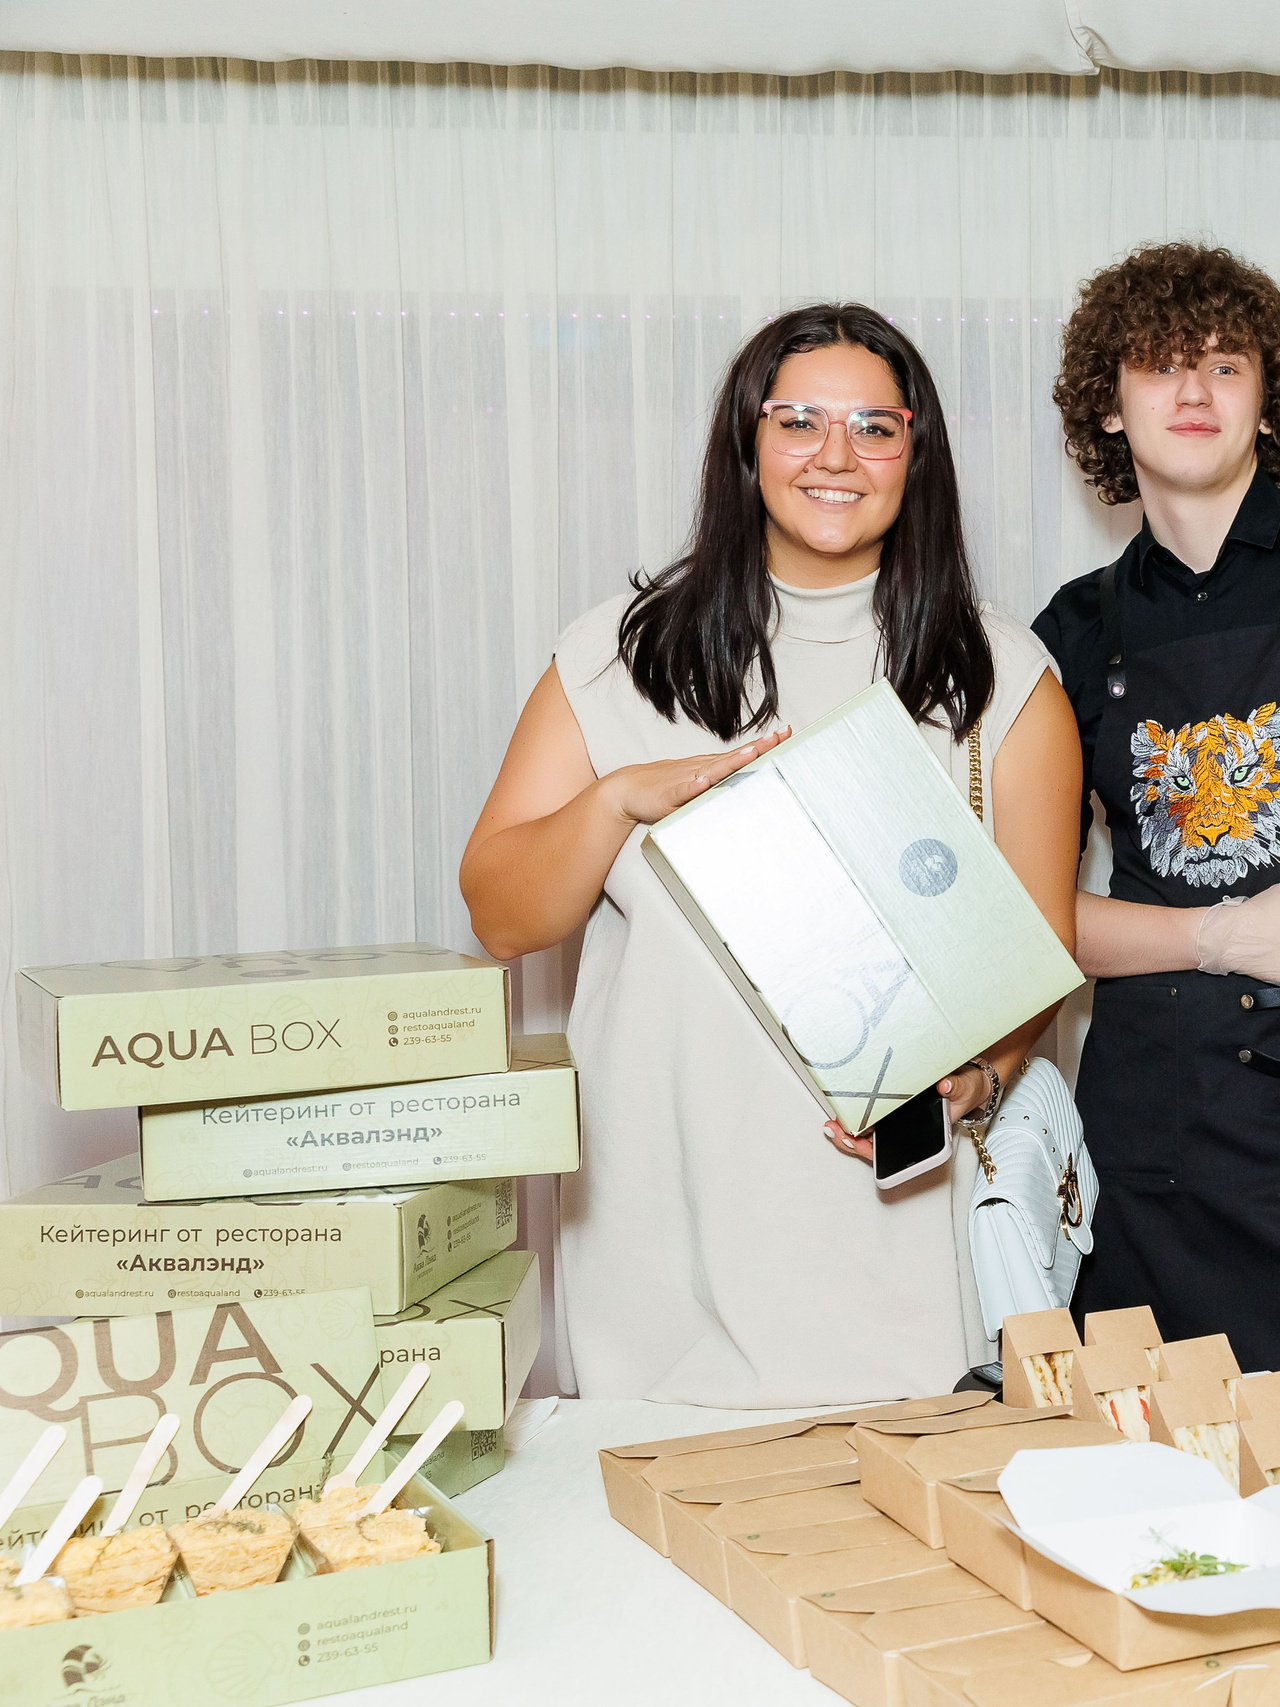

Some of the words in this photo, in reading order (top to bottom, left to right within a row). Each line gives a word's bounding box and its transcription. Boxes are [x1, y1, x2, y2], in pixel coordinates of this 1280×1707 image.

[402, 1006, 482, 1019] aqualandrest.ru
[403, 1019, 475, 1033] restoaqualand
[91, 1027, 234, 1068] AQUA
[250, 1018, 342, 1055] BOX
[403, 1033, 452, 1046] 239-63-55
[201, 1099, 341, 1126] Кейтеринг
[349, 1102, 376, 1116] от
[390, 1090, 521, 1118] ресторана
[286, 1125, 443, 1149] «Аквалэнд»
[253, 1164, 328, 1177] aqualandrest.ru
[352, 1157, 418, 1170] restoaqualand
[443, 1153, 487, 1164] 239-63-55
[40, 1225, 170, 1247] Кейтеринг
[177, 1229, 202, 1242] от
[216, 1228, 342, 1247] ресторана
[116, 1255, 265, 1274] «Аквалэнд»
[85, 1289, 154, 1299] aqualandrest.ru
[177, 1289, 240, 1299] restoaqualand
[0, 1302, 283, 1422] QUA
[139, 1509, 169, 1527] от
[185, 1484, 325, 1523] реторан
[317, 1604, 417, 1631] aqualandrest.ru
[317, 1621, 408, 1647] restoaqualand
[317, 1642, 379, 1664] 239-63-55
